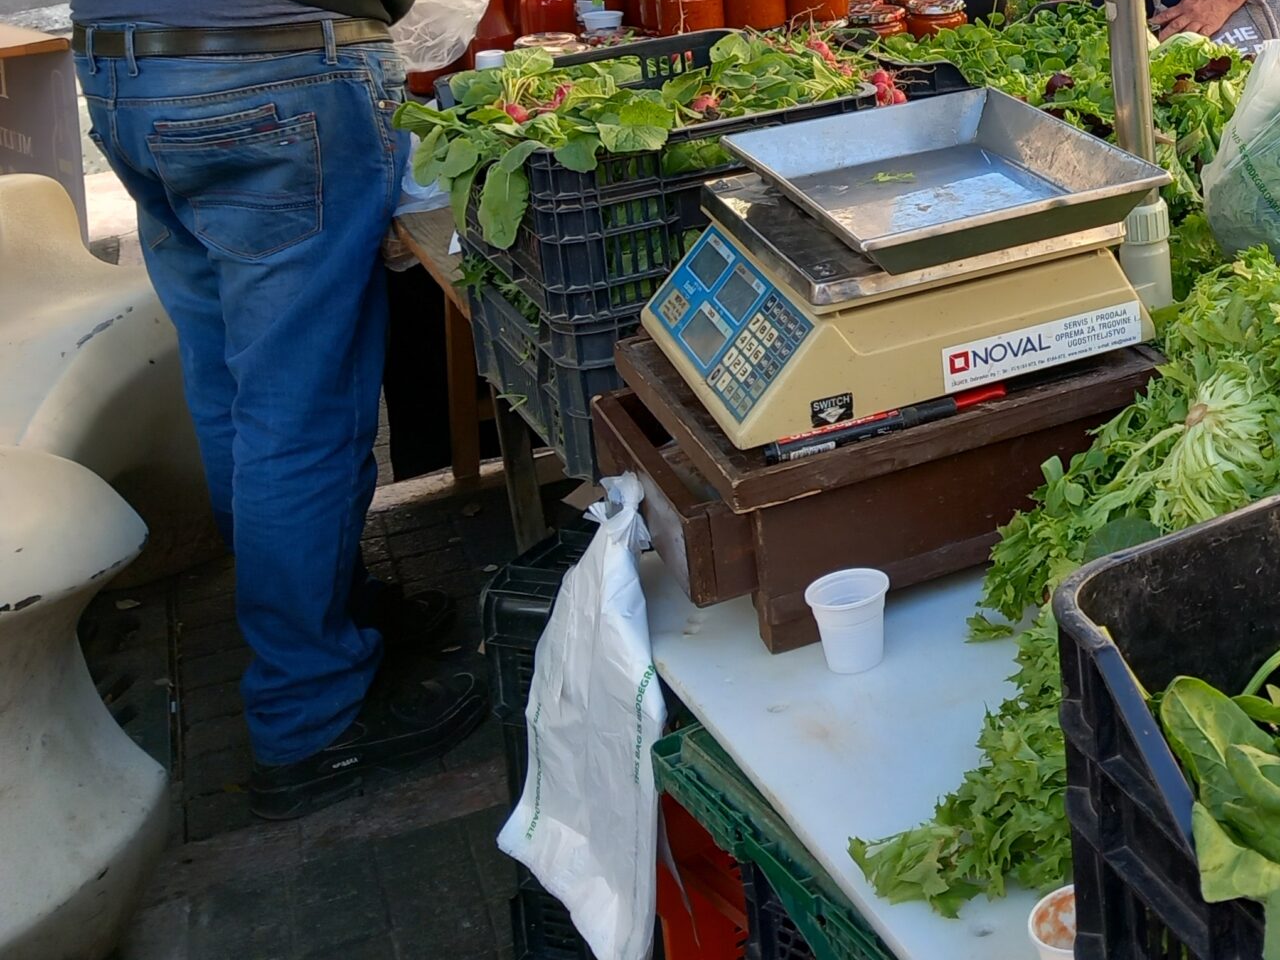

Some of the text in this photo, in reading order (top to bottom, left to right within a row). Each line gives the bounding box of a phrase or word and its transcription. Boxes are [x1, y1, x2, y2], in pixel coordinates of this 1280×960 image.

[752, 318, 760, 327] 7
[760, 324, 768, 335] 8
[767, 332, 775, 342] 9
[1055, 328, 1085, 342] OPREMA
[1087, 325, 1096, 334] ZA
[1098, 315, 1132, 330] TRGOVINE
[1063, 317, 1089, 331] SERVIS
[1095, 308, 1128, 322] PRODAJA
[740, 335, 748, 344] 4
[746, 343, 755, 354] 5
[753, 350, 762, 361] 6
[1067, 326, 1126, 348] UGOSTITELJSTVO
[971, 333, 1052, 368] NOVAL
[732, 359, 741, 369] 2
[740, 366, 748, 377] 3
[813, 395, 850, 412] SWITCH
